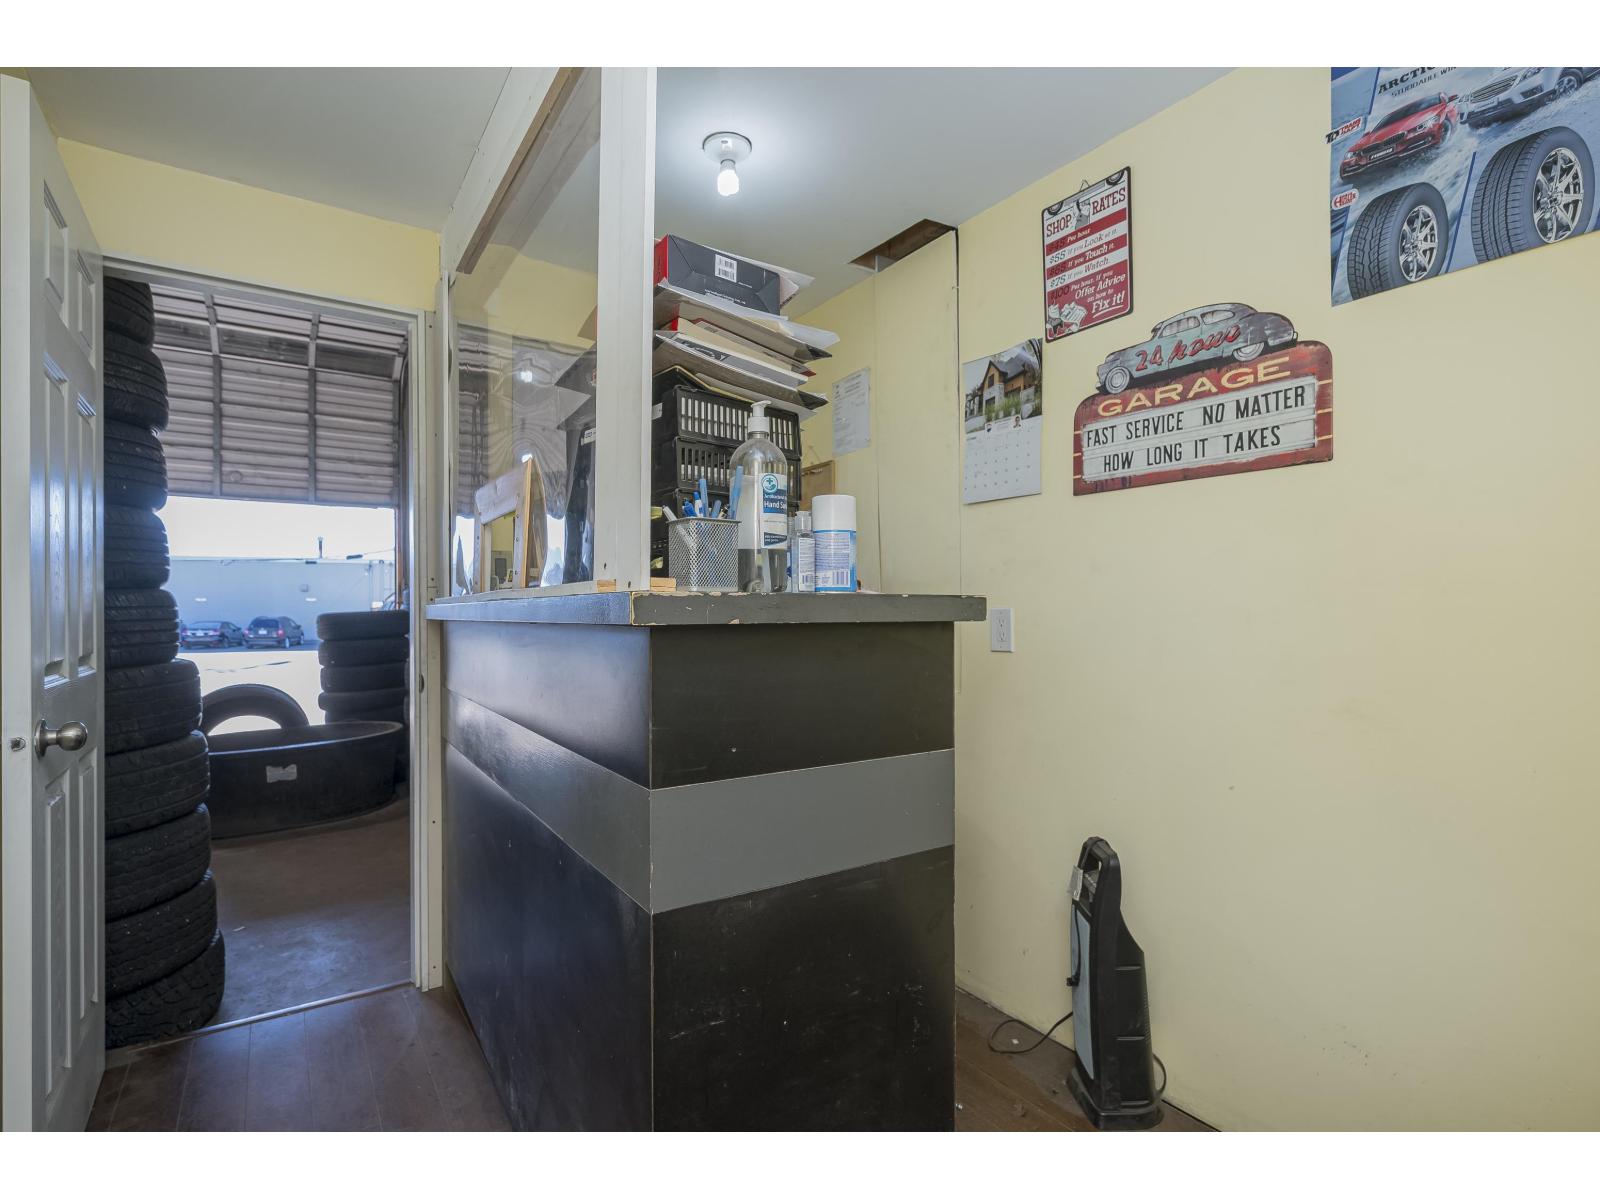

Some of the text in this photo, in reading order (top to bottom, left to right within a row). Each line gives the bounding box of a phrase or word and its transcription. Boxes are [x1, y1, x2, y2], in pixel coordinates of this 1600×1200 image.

[1046, 187, 1126, 238] SHOP RATES
[1077, 228, 1091, 241] hour
[1049, 249, 1066, 264] $55
[1084, 234, 1104, 248] Look
[1074, 256, 1085, 266] you
[1085, 244, 1108, 260] Touch
[1049, 274, 1066, 288] $75
[1075, 273, 1126, 299] Offer Advice
[1102, 270, 1114, 280] you
[1091, 290, 1126, 314] Fix it!
[1095, 291, 1107, 301] how
[1134, 345, 1164, 372] 24
[1097, 356, 1291, 417] GARAGE
[1087, 385, 1306, 447] FAST SERVICE NO MATTER
[1103, 425, 1281, 473] HOW LONG IT TAKES
[764, 501, 780, 509] Hand
